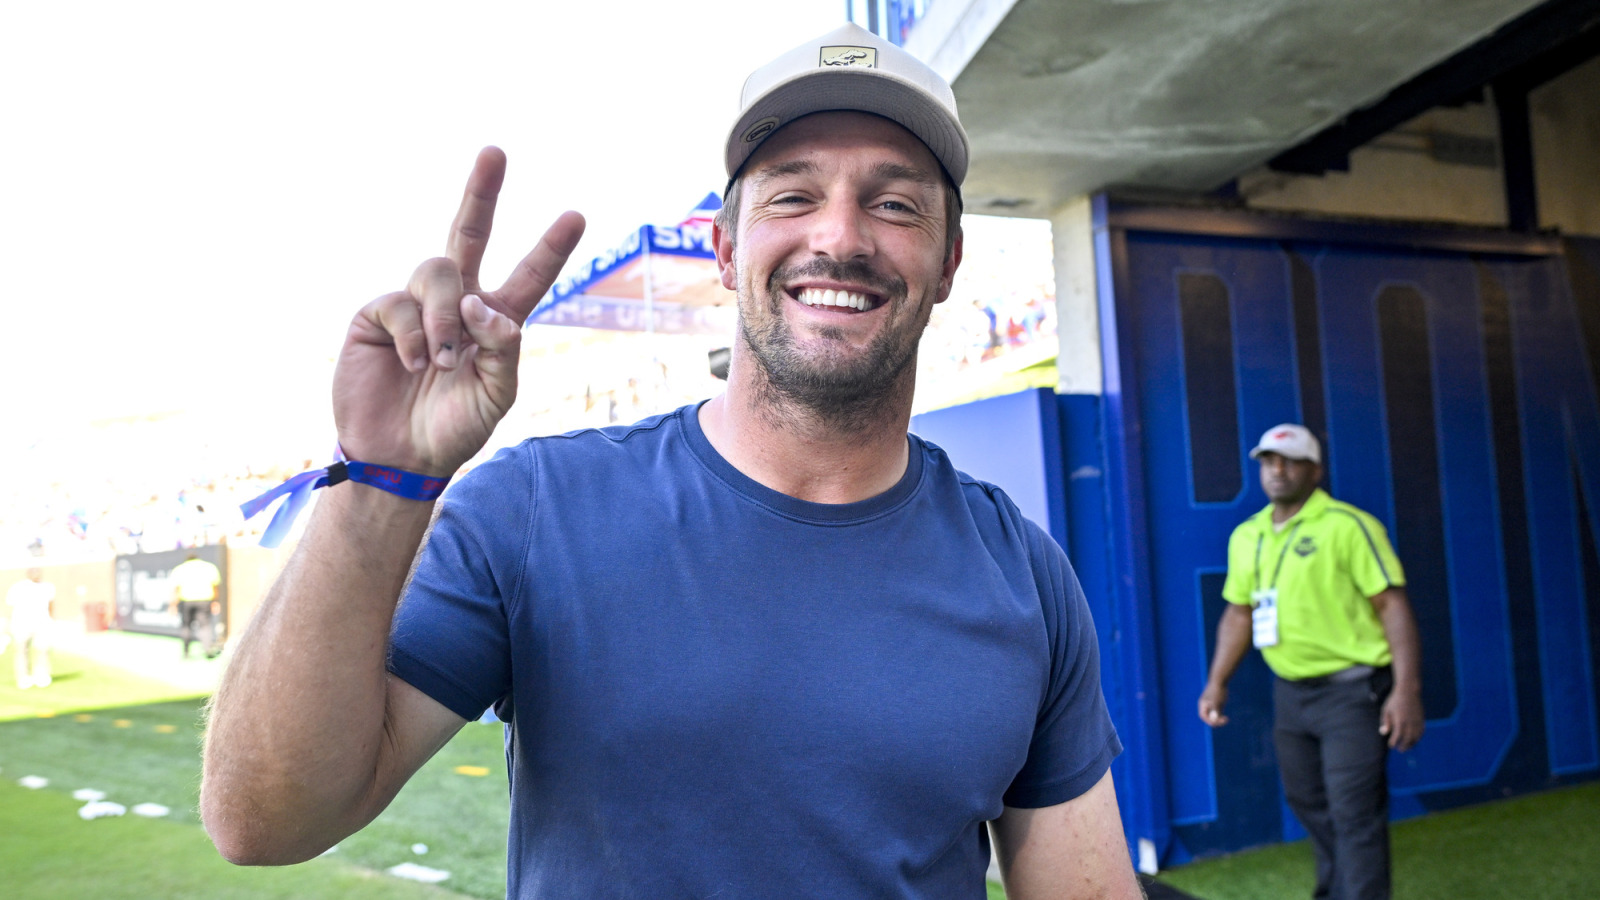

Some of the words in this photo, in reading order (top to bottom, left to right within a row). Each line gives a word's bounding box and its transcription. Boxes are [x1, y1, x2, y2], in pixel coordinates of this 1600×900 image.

[653, 226, 713, 251] SM
[363, 466, 402, 484] SMU
[421, 479, 445, 492] SM
